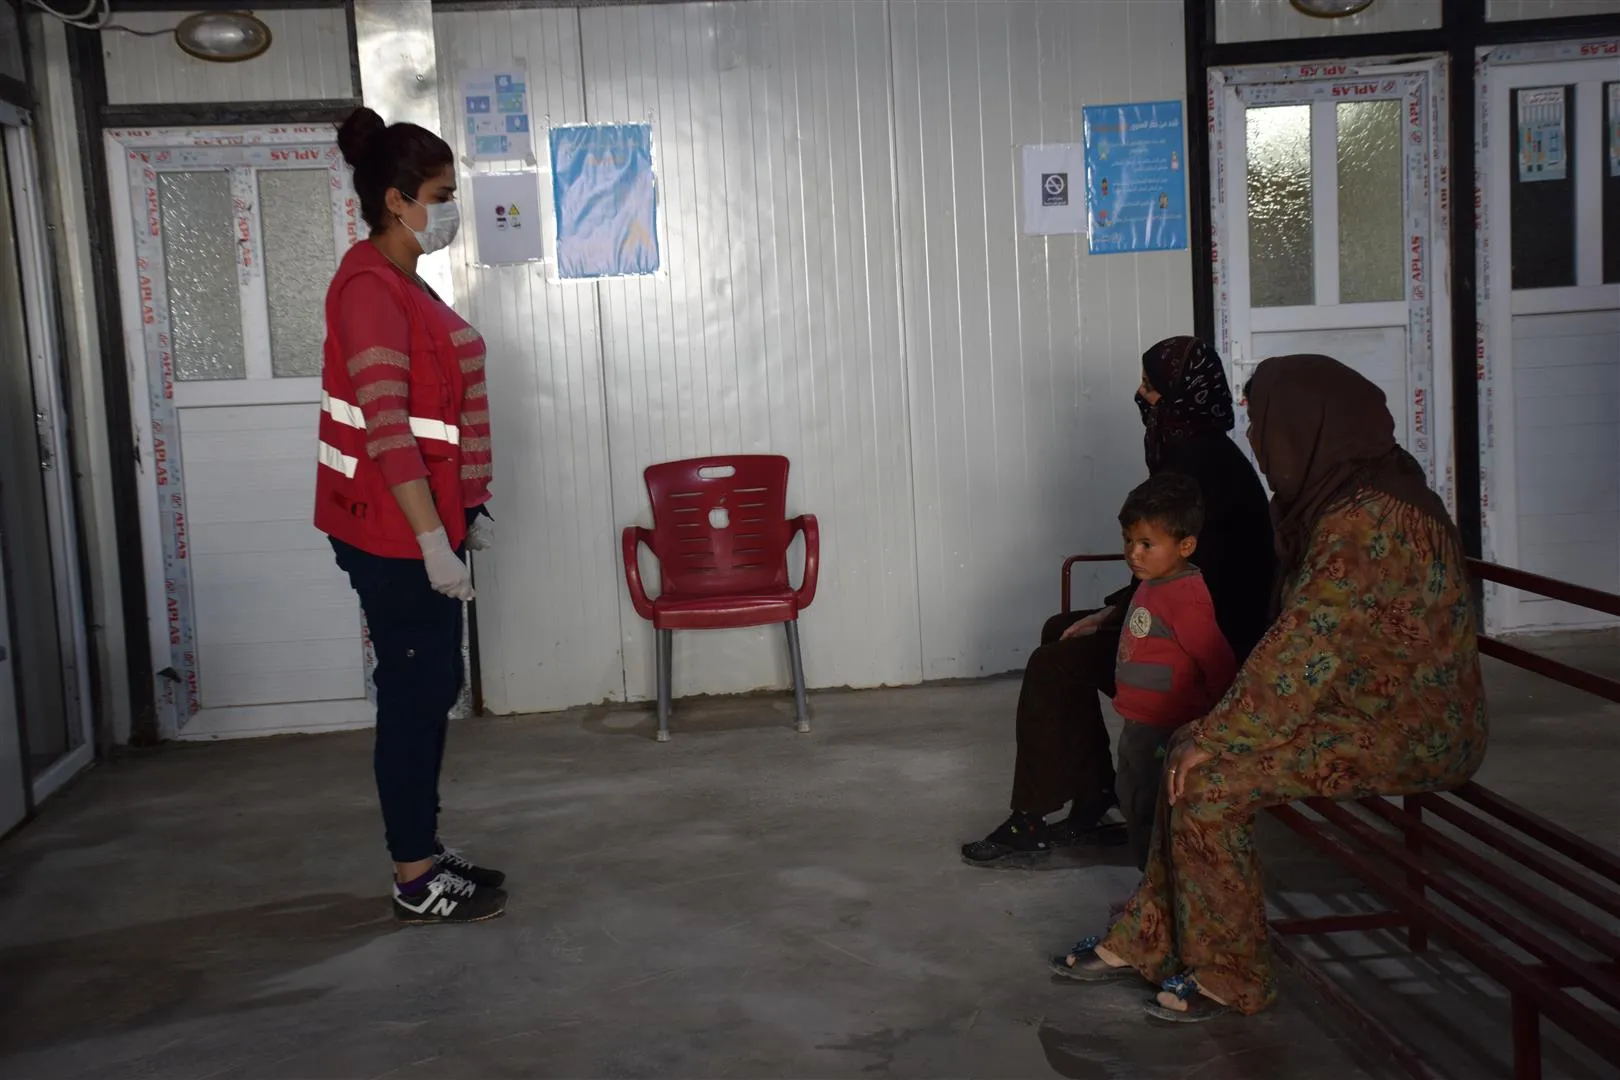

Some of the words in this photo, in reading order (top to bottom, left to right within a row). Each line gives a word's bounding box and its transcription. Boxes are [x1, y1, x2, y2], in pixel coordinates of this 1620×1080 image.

[1331, 84, 1378, 97] APLAS
[270, 149, 319, 161] APLAS
[147, 187, 159, 237] APLAS
[1411, 235, 1422, 282] APLAS
[140, 276, 154, 325] APLAS
[162, 351, 174, 400] APLAS
[1414, 388, 1425, 433] APLAS
[153, 438, 168, 487] APLAS
[175, 511, 187, 560] APLAS
[168, 597, 180, 646] APLAS
[431, 897, 458, 917] N
